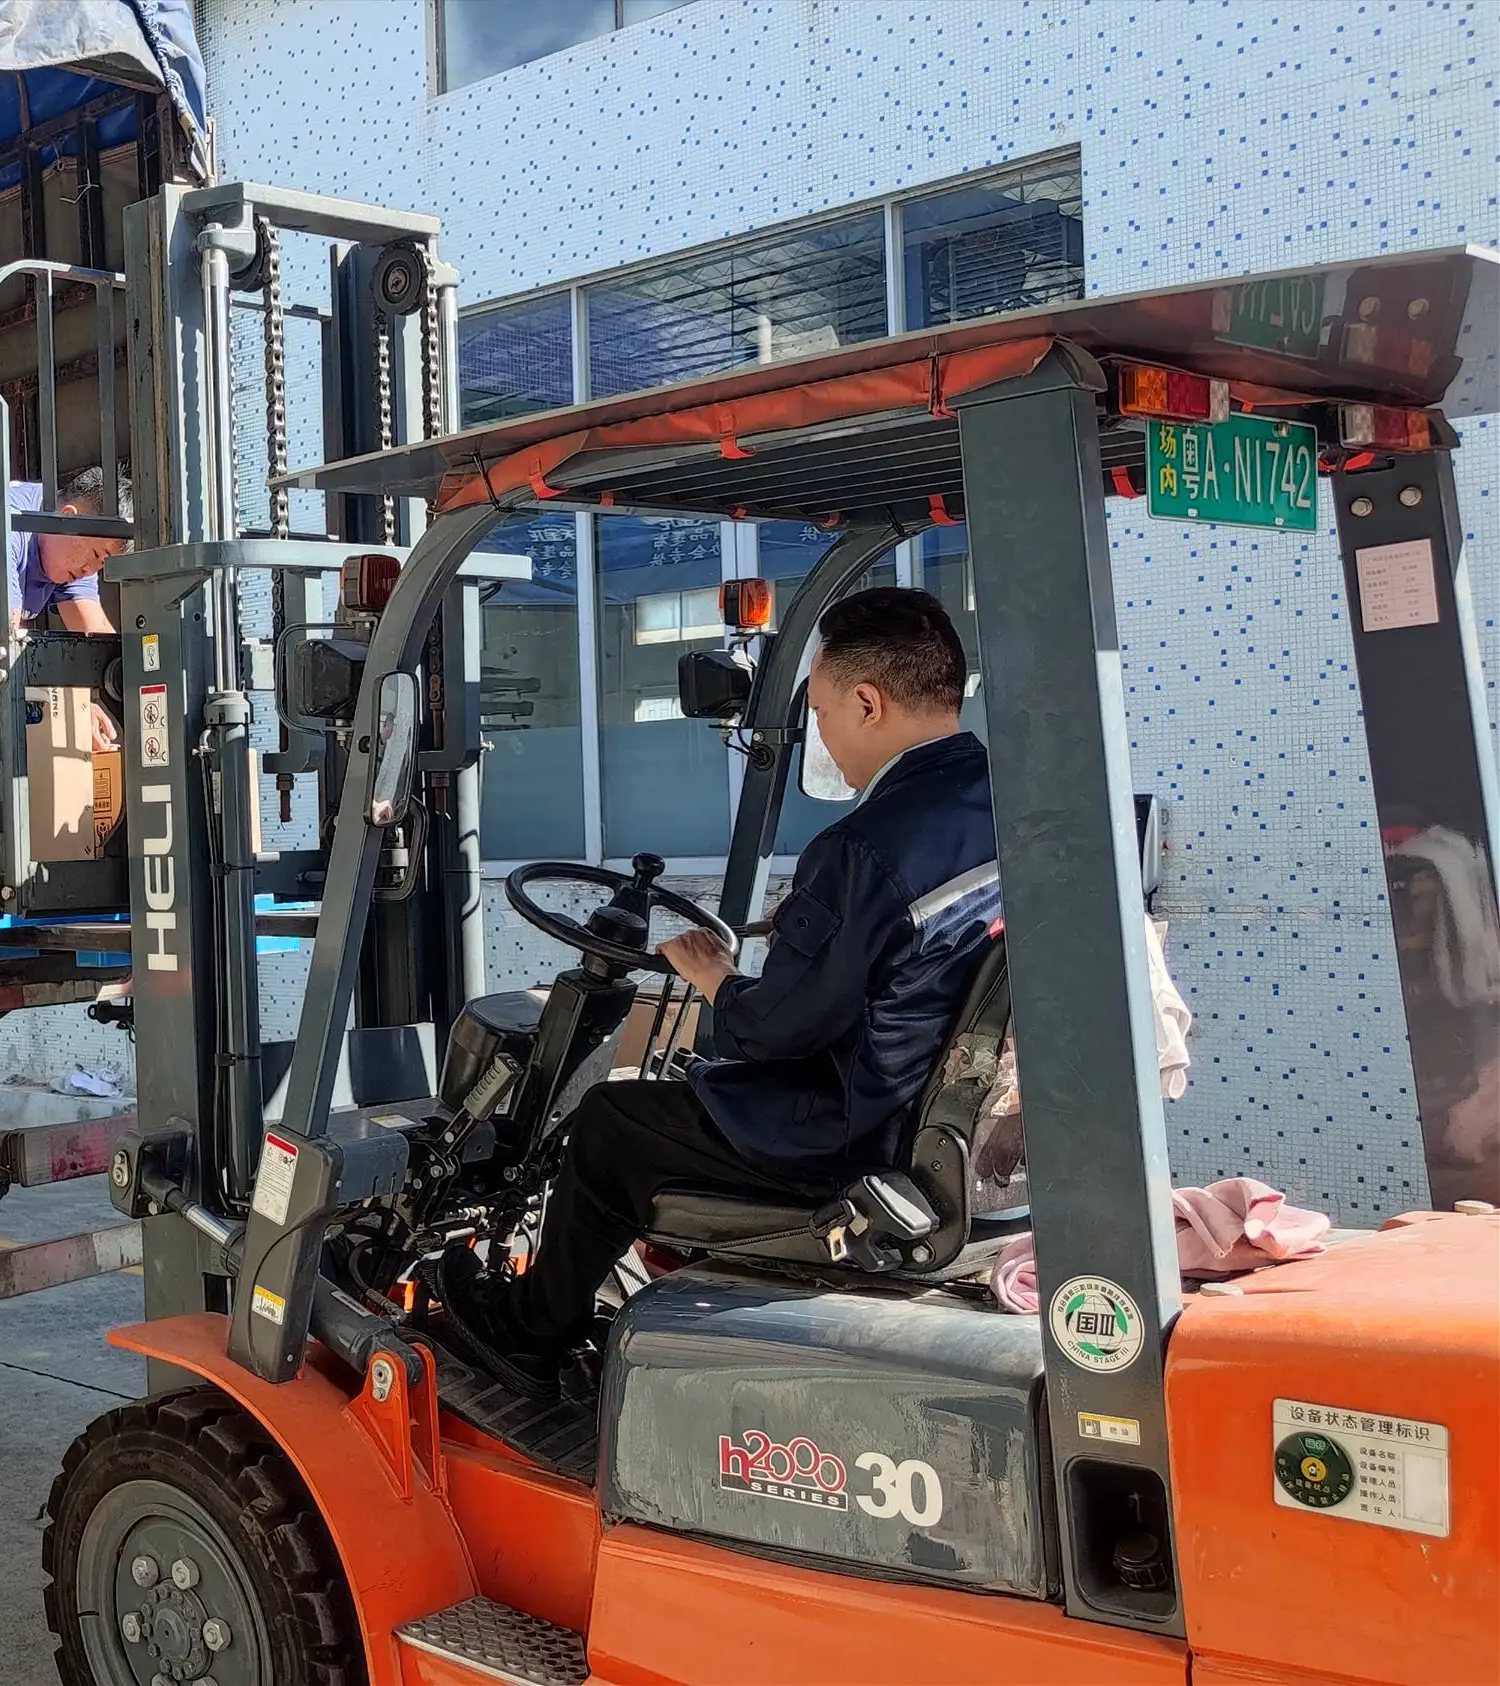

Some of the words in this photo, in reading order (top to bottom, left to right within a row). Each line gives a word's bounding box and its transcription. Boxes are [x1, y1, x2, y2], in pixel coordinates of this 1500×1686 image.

[1160, 424, 1177, 497] 场内
[141, 784, 178, 971] HELI
[1067, 1340, 1090, 1361] CHINA
[1093, 1353, 1120, 1364] STAGE
[1290, 1405, 1431, 1442] 设备状态管理标识
[750, 1481, 840, 1507] SERIES
[855, 1452, 943, 1527] 30
